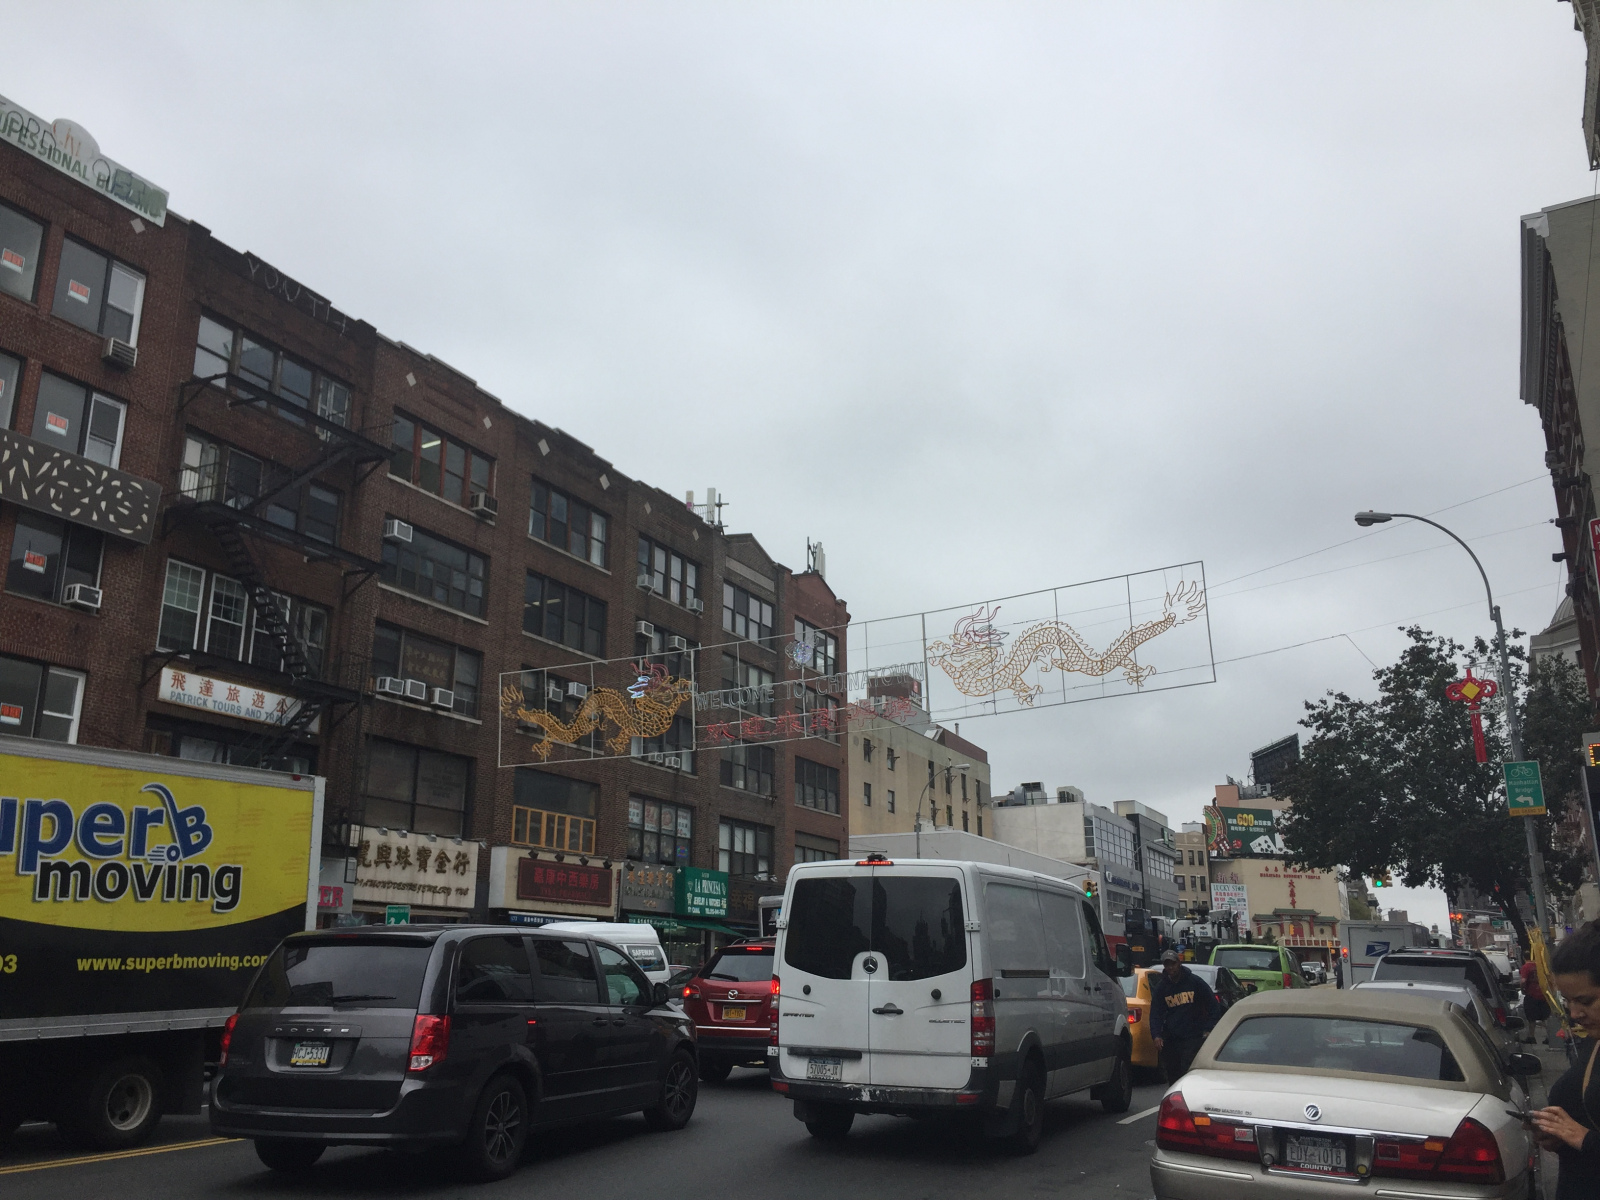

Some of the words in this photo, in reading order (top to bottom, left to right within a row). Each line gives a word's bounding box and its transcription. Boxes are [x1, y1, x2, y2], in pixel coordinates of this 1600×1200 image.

[170, 690, 208, 708] PATRICK
[212, 700, 242, 715] TOURS
[244, 707, 262, 719] AND
[694, 685, 775, 711] WELCOME
[783, 680, 807, 699] TO
[815, 662, 924, 696] CHINATOWN
[36, 860, 243, 913] moving
[1300, 1163, 1332, 1171] COUNTRY
